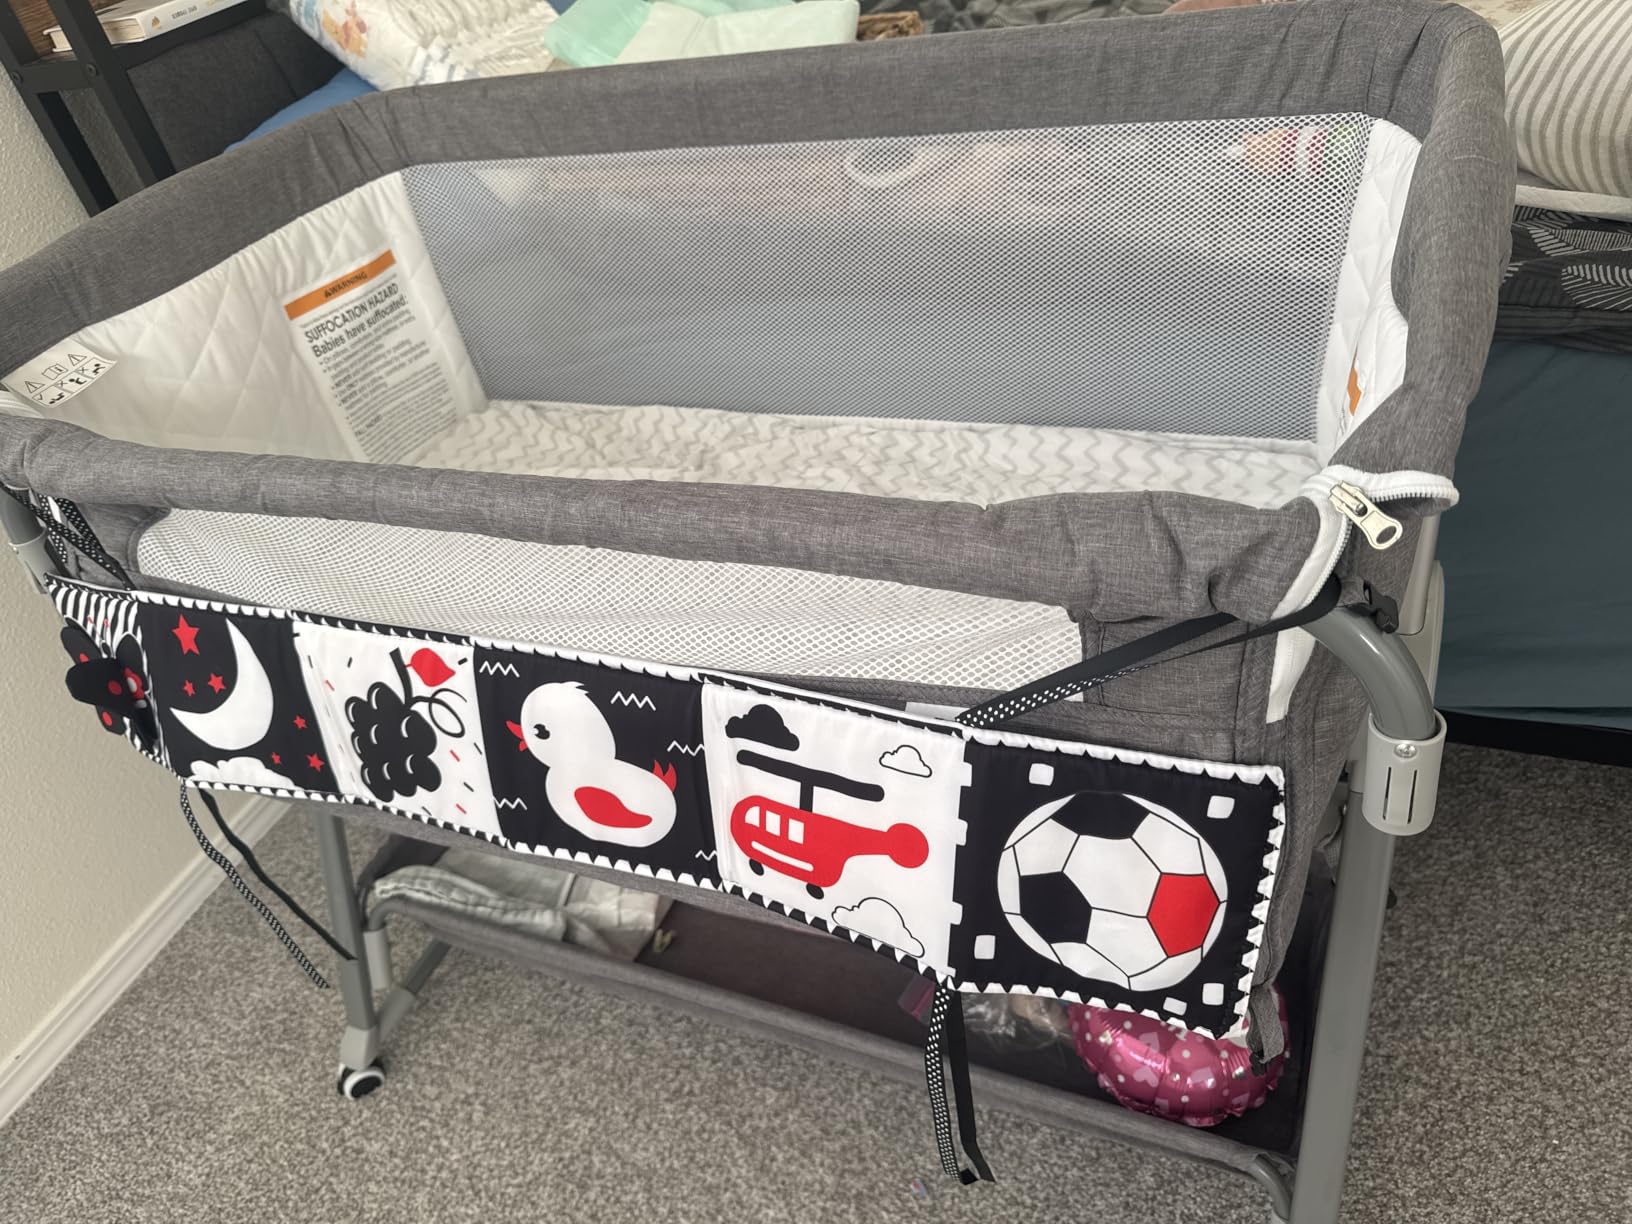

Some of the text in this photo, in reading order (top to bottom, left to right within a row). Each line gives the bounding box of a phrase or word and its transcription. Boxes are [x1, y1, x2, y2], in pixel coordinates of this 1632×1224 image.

[304, 303, 369, 343] SUFFOCATION
[367, 283, 399, 310] HAZARD
[329, 271, 368, 295] WARNING
[311, 335, 346, 358] Babies
[344, 322, 367, 339] have
[366, 294, 409, 328] suffocated:
